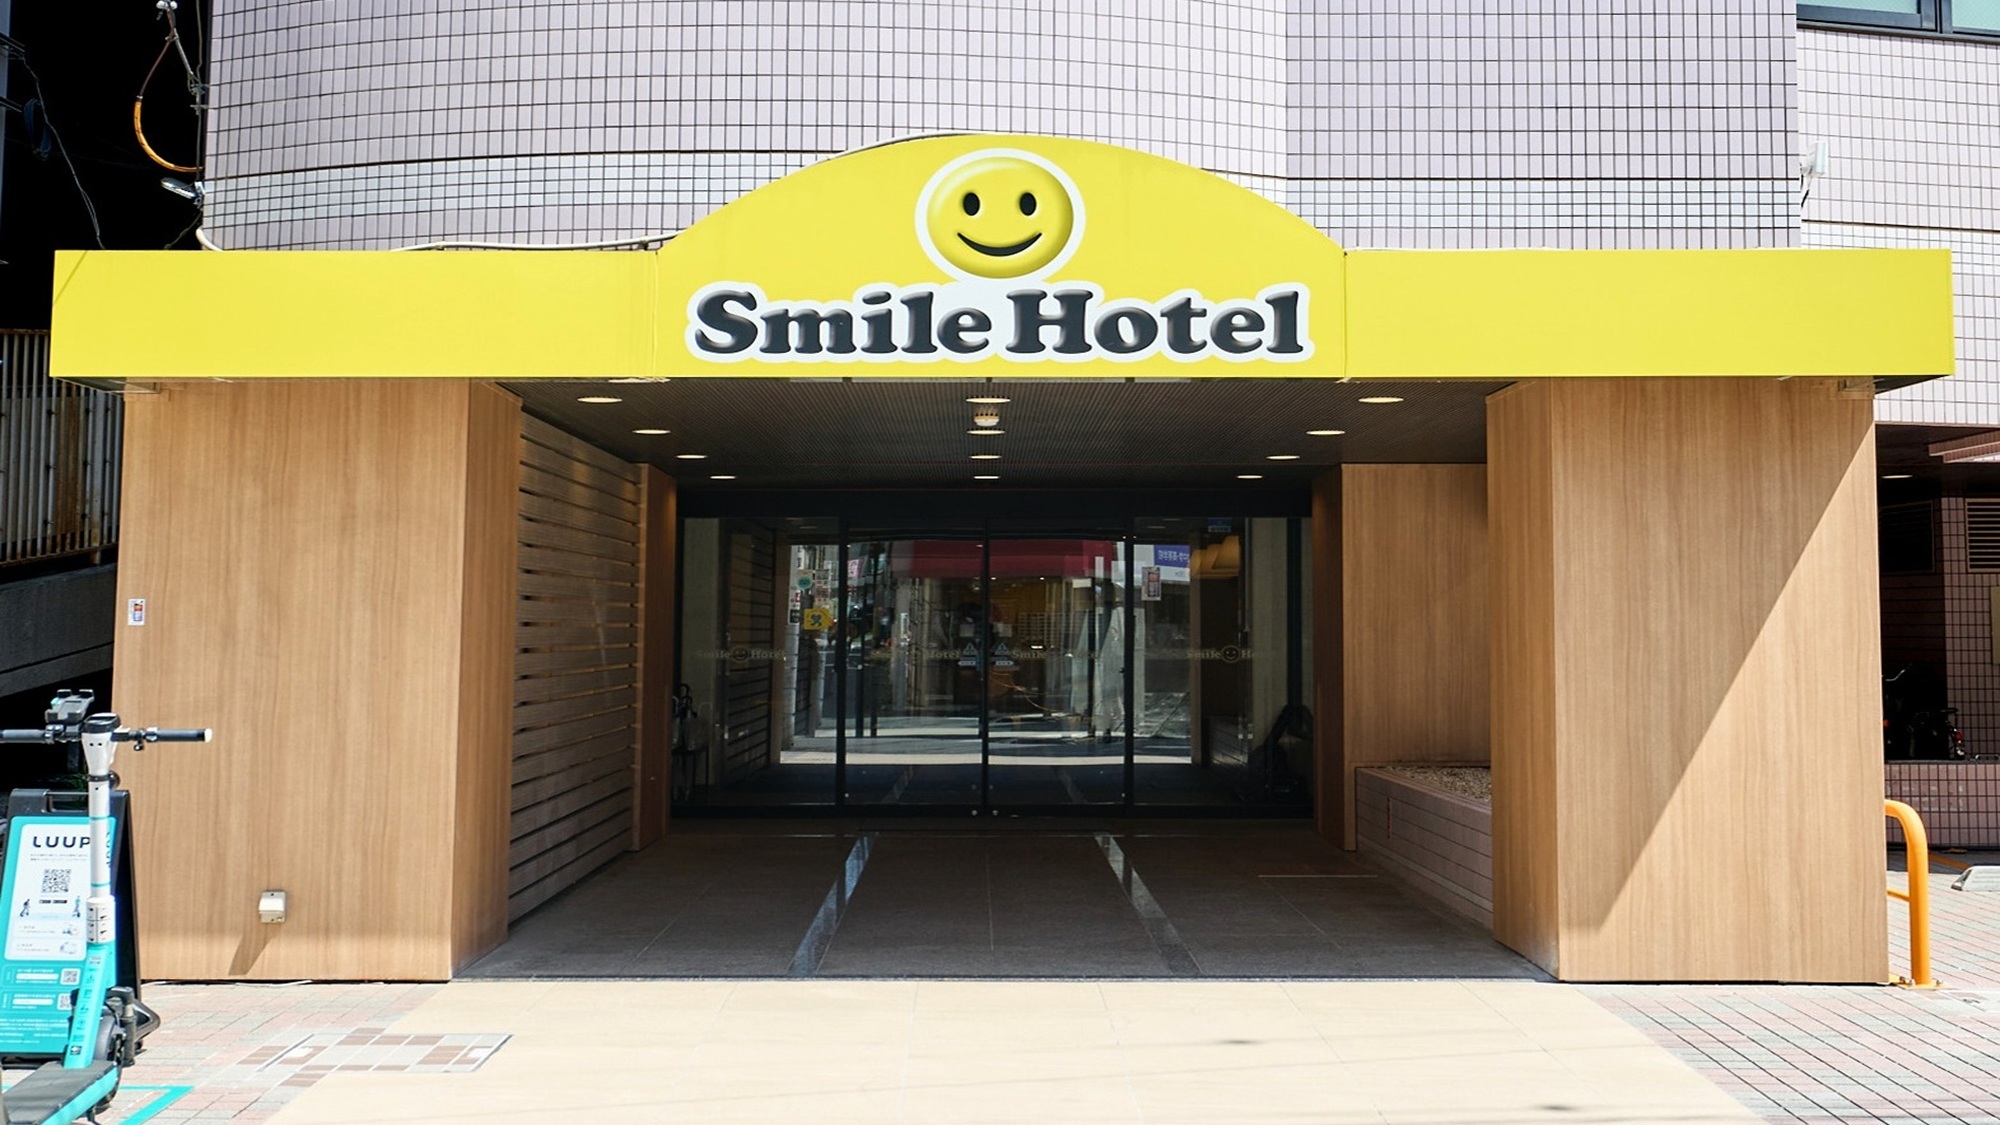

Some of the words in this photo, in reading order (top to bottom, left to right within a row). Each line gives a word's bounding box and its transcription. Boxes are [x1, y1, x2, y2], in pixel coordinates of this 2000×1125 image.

[694, 290, 992, 354] Smile
[1006, 290, 1305, 354] Hotel
[33, 836, 91, 848] LUUP
